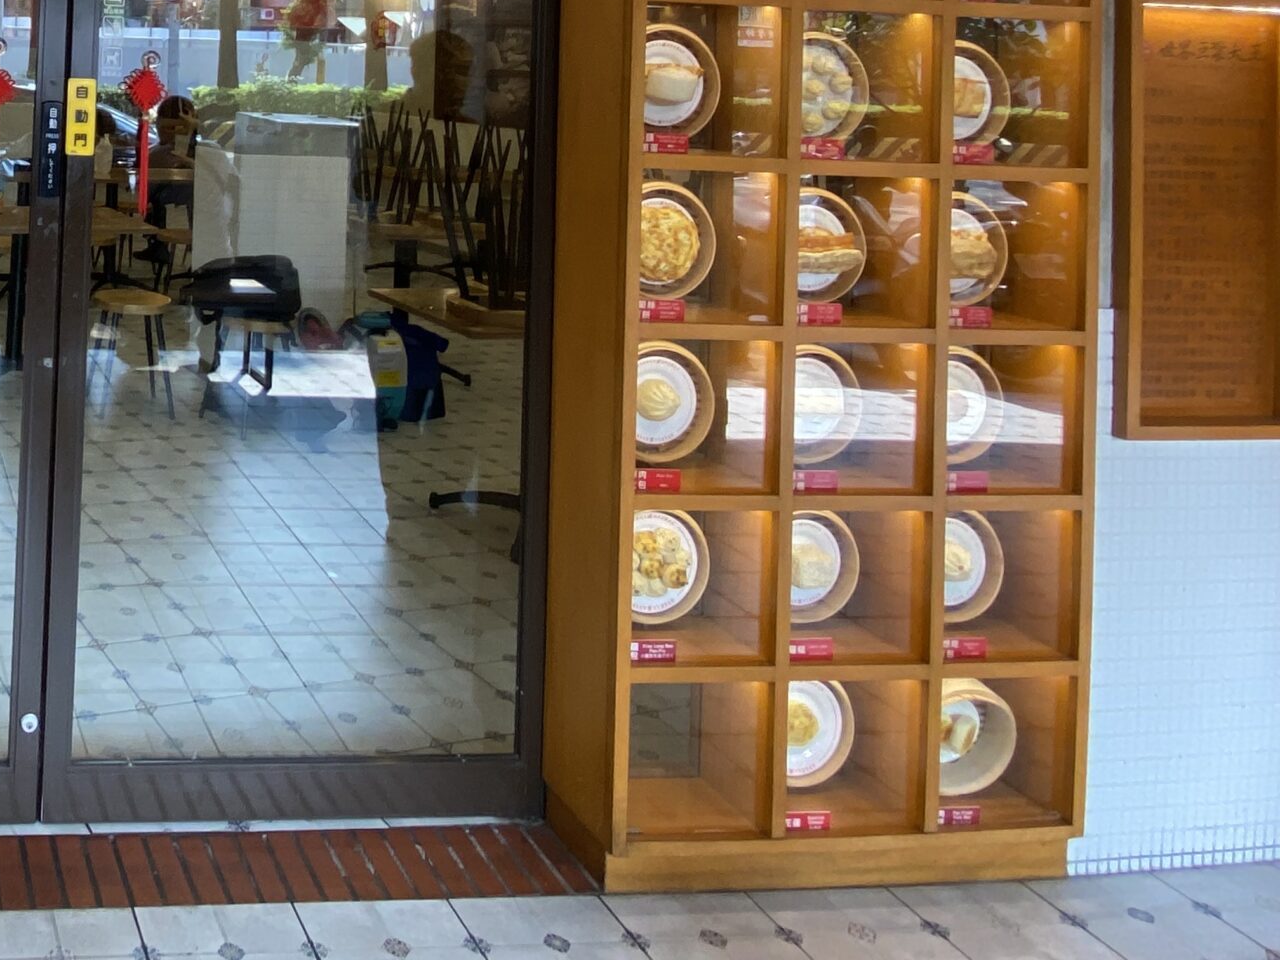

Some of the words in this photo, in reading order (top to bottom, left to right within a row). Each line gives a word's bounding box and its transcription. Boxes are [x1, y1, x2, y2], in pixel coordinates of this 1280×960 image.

[49, 108, 58, 128] 自動
[74, 86, 89, 147] 自動門
